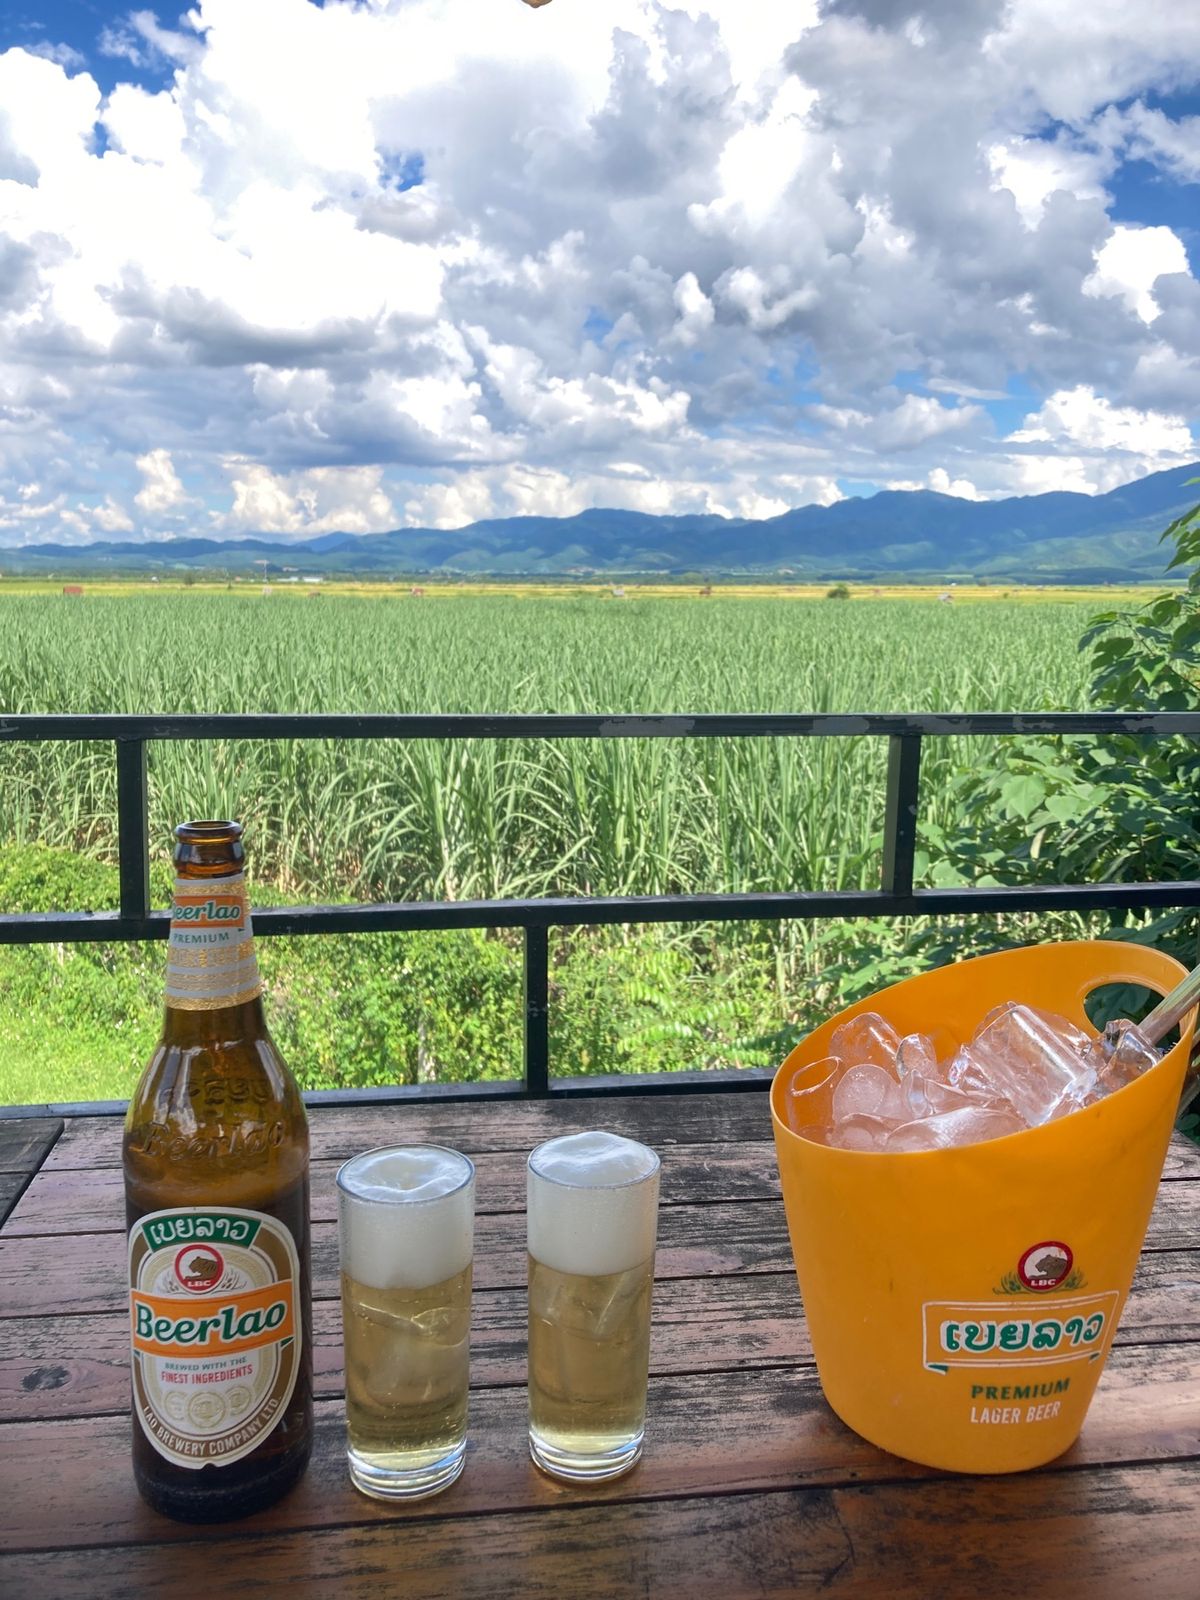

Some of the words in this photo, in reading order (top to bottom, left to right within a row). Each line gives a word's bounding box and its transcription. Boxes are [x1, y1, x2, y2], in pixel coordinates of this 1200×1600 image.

[172, 900, 241, 921] eerlao
[173, 931, 230, 944] PREMIUM
[150, 1217, 249, 1245] ເບຍລາວ
[1030, 1278, 1057, 1287] LBC
[135, 1301, 287, 1345] Beerlao
[942, 1312, 1104, 1353] ເບຍລາວ
[161, 1371, 189, 1385] FINEST
[191, 1364, 254, 1385] INGREDIENTS
[165, 1361, 200, 1372] BREWED
[202, 1361, 228, 1371] WITH
[230, 1356, 248, 1366] THE
[970, 1377, 1071, 1400] PREMIUM
[970, 1406, 1021, 1425] LAGER
[1026, 1400, 1061, 1423] BEER
[143, 1405, 157, 1431] LAO
[156, 1425, 206, 1456] BREWERY
[209, 1420, 263, 1456] COMPANY
